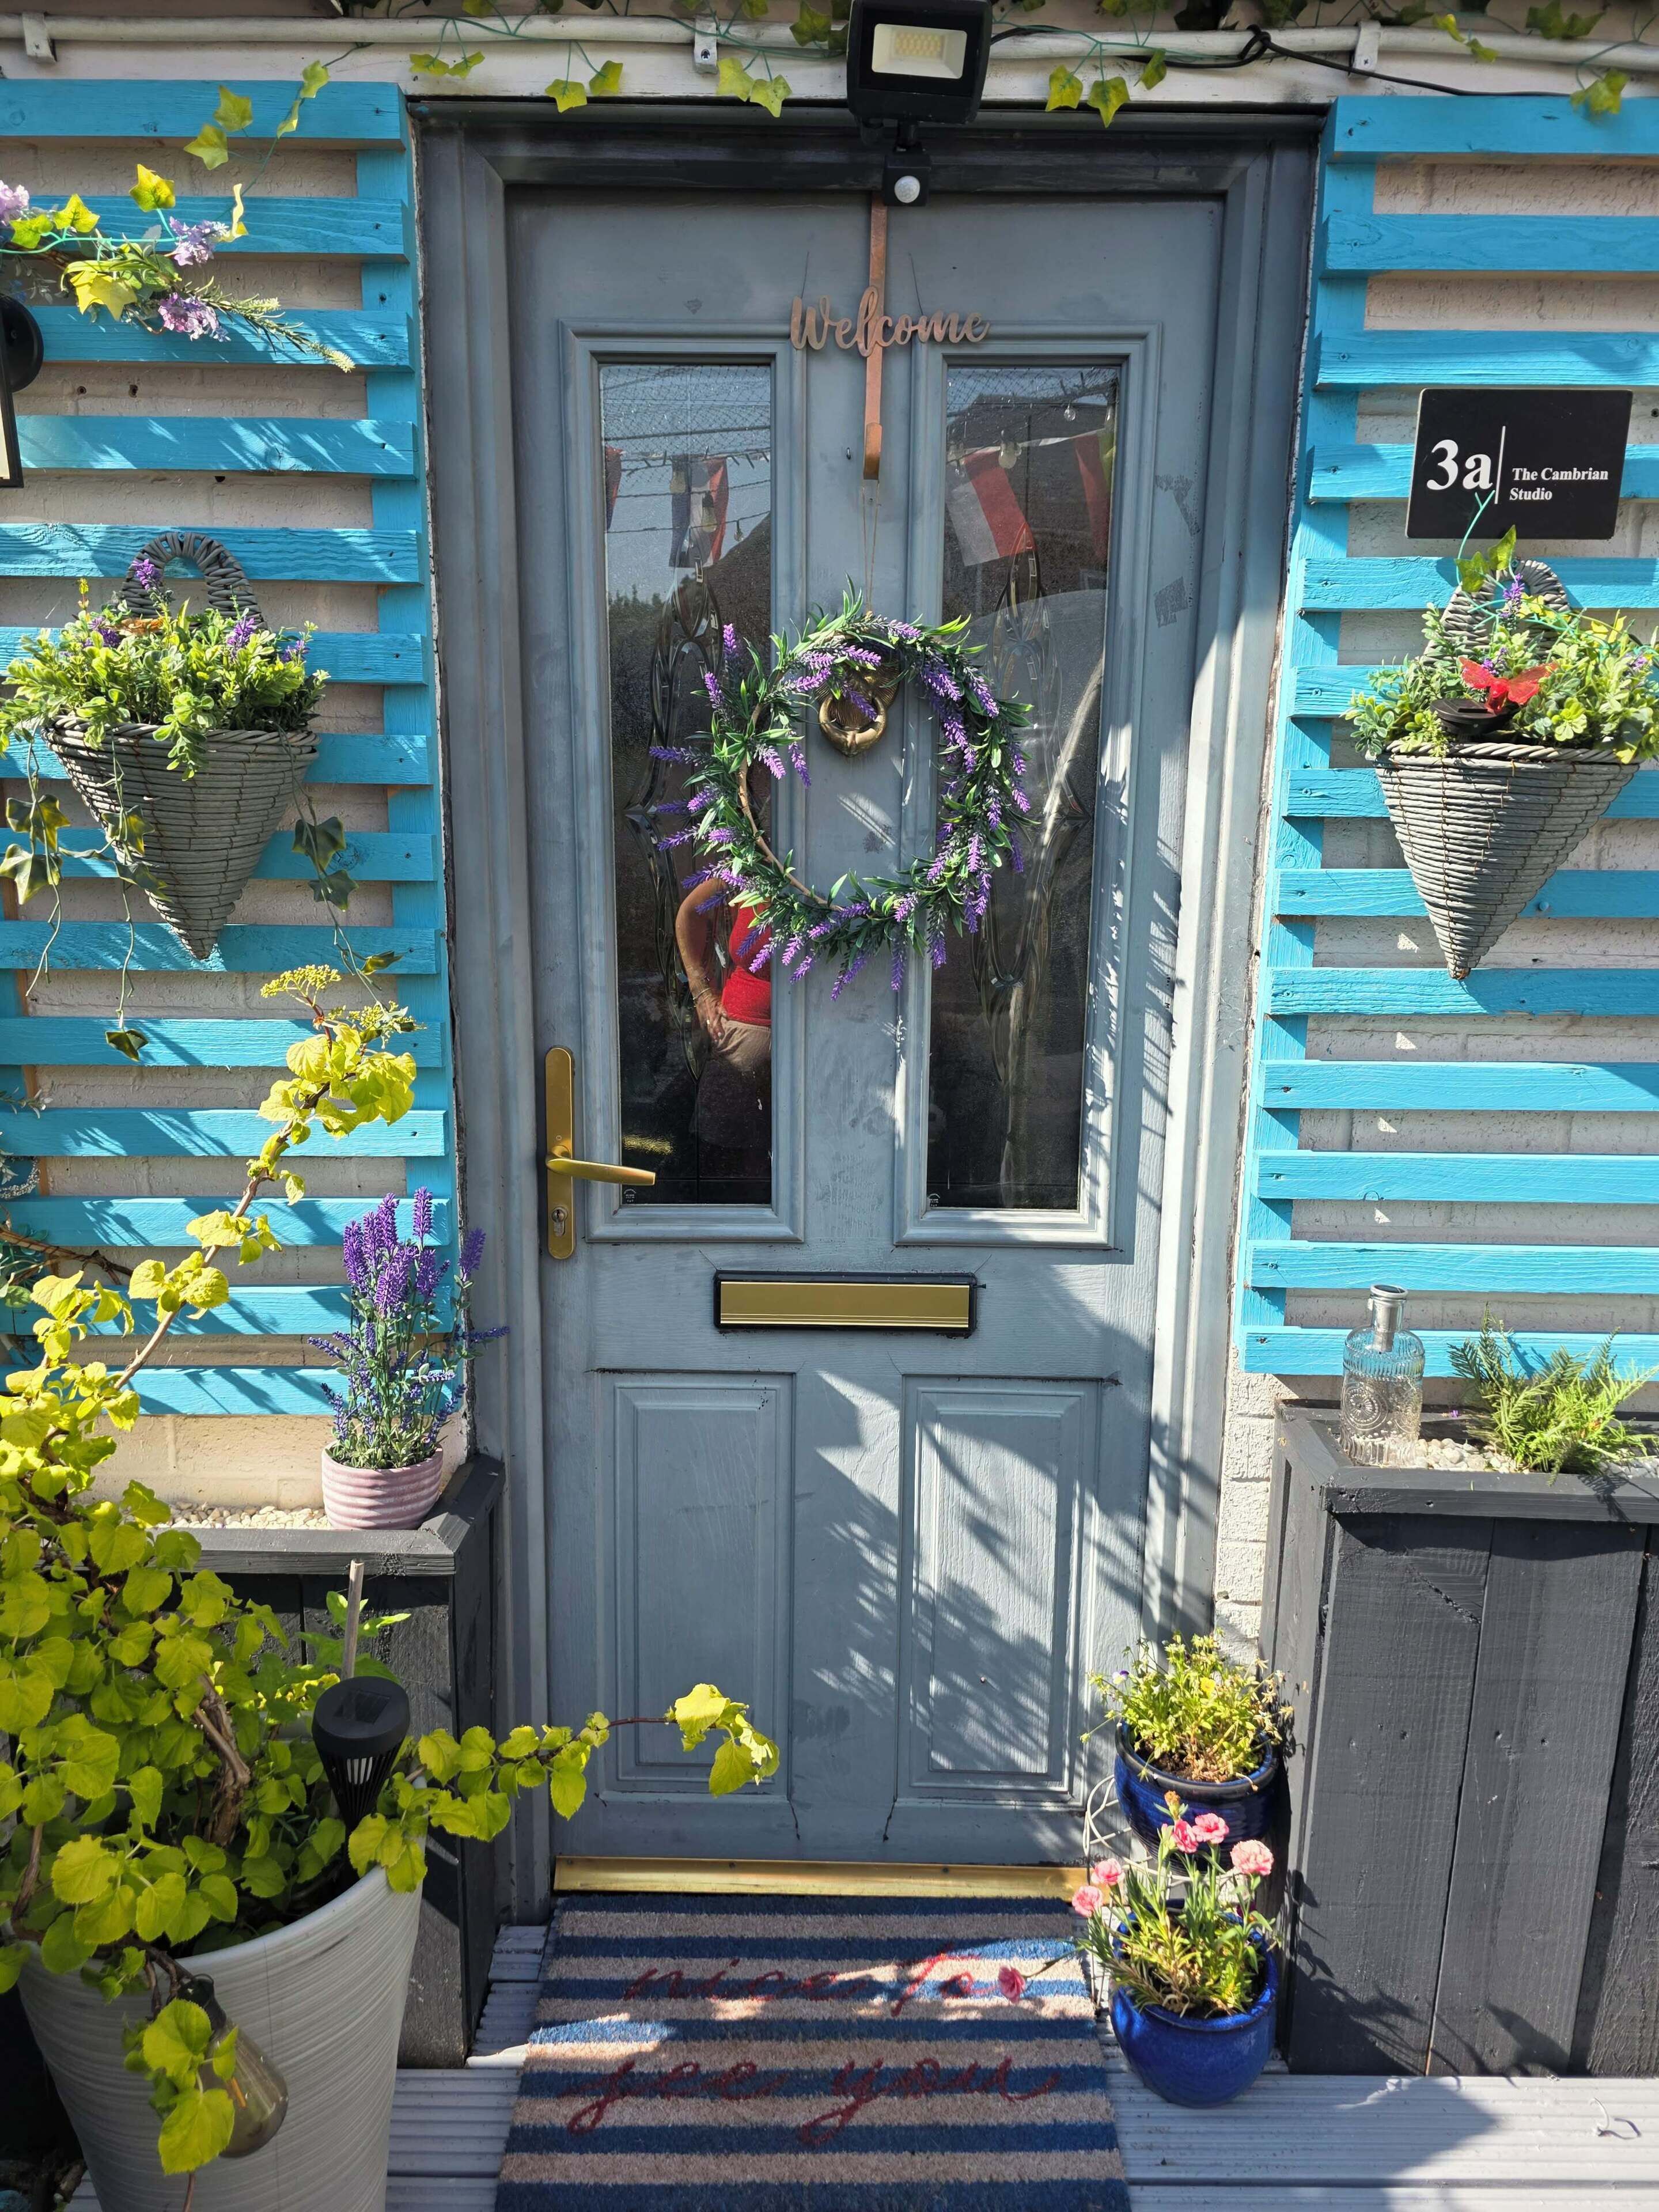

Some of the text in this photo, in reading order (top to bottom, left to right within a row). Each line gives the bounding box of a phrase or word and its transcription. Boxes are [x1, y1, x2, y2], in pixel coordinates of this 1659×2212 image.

[790, 285, 990, 357] Welcome
[1427, 439, 1493, 490] 3a
[1512, 467, 1609, 480] The Cambrian
[1509, 487, 1553, 501] Studio
[623, 1957, 866, 2002] nice
[556, 2055, 1062, 2145] see you
